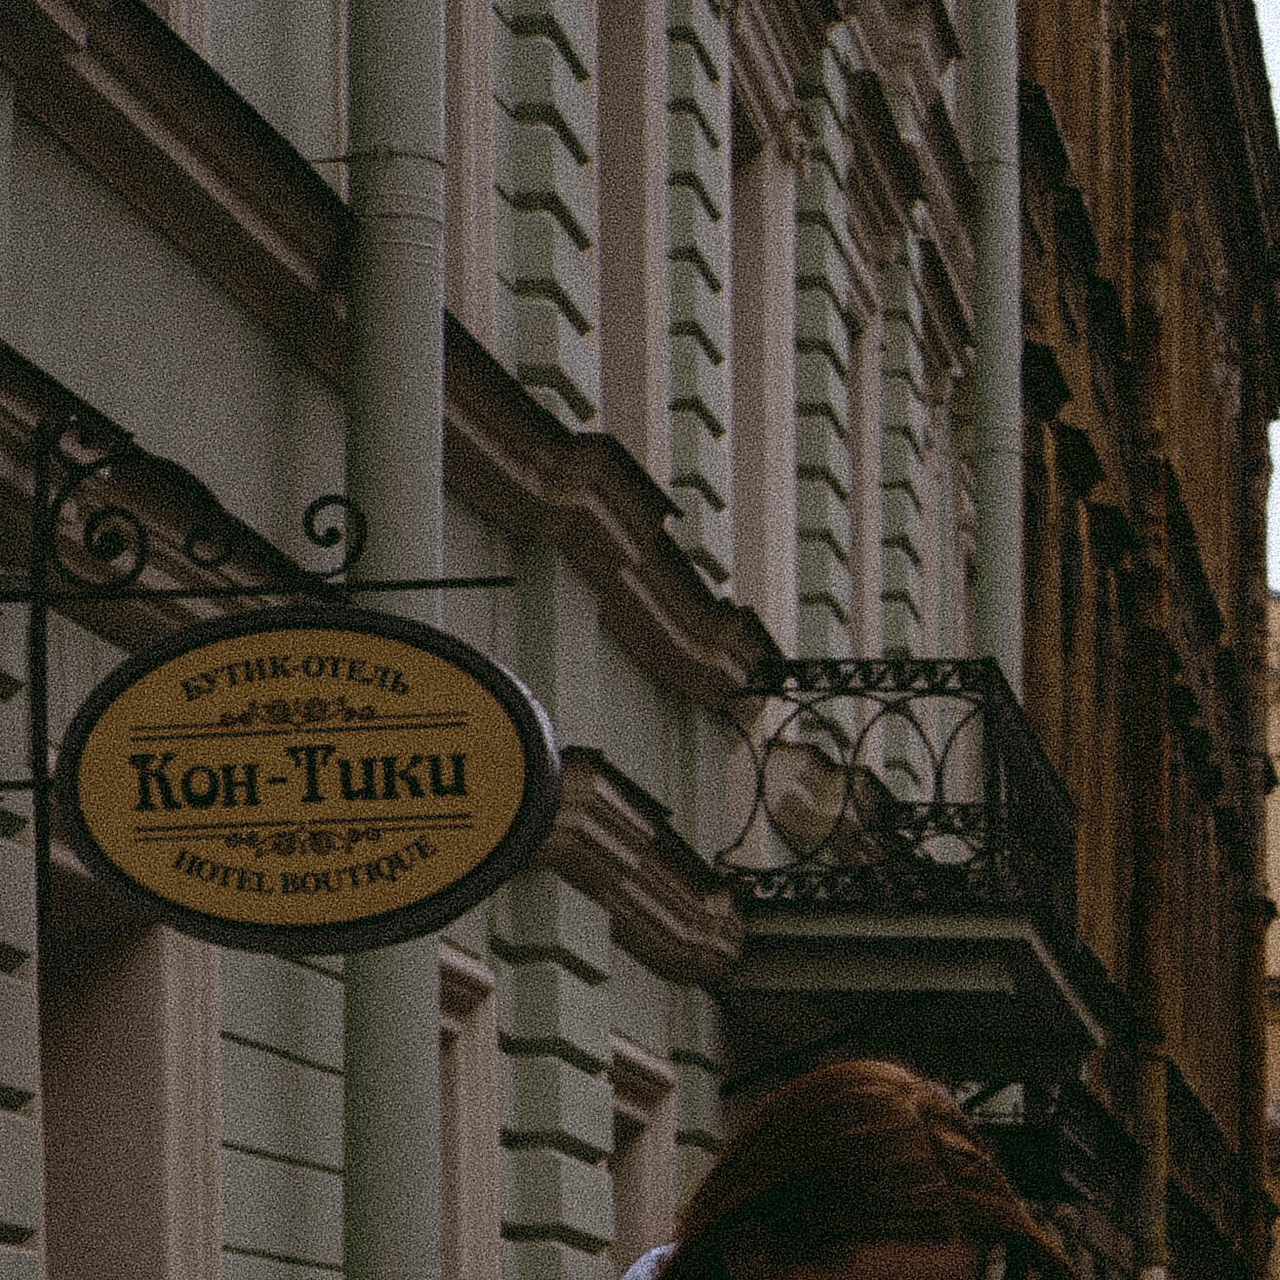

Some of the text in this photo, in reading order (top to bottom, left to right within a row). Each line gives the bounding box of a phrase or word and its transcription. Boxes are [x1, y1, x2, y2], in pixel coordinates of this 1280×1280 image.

[179, 655, 409, 702] БУТИК-ОТЕЛЬ
[130, 743, 469, 812] Кон-Тики
[173, 835, 437, 895] HOTEL BOUTIQUE
